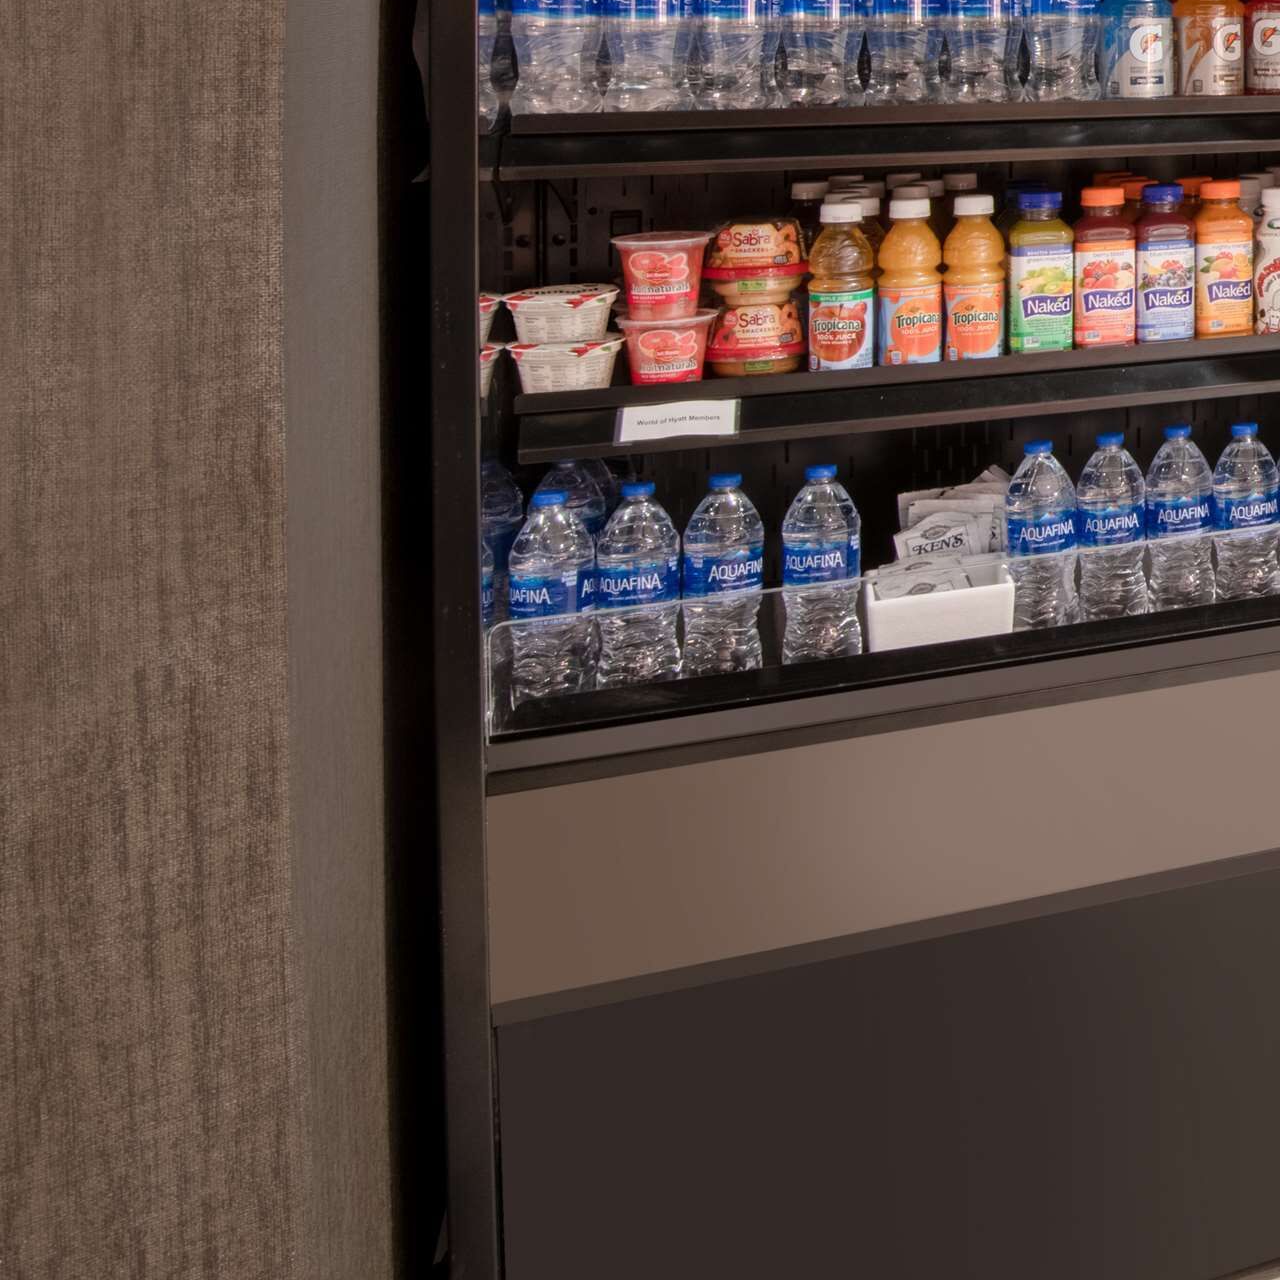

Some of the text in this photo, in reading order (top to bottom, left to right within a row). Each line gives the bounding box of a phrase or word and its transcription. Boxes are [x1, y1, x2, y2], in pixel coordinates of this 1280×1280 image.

[1129, 24, 1163, 64] G
[1213, 24, 1241, 62] G
[731, 232, 771, 247] Sabra
[1088, 291, 1131, 308] Naked
[1148, 291, 1191, 307] Naked
[1212, 284, 1252, 299] Naked
[1027, 297, 1071, 314] Naked
[738, 313, 777, 328] Sabra
[812, 320, 862, 333] Tropicana
[896, 312, 941, 328] Tropicana
[952, 311, 998, 326] Tropicana
[636, 414, 721, 427] World of Hyatt Members
[1158, 503, 1210, 524] AQUAFINA
[1019, 519, 1075, 543] AQUAFINA
[1084, 513, 1139, 533] AQUAFINA
[912, 532, 964, 556] KEN'S
[785, 553, 844, 571] AQUAFINA
[600, 573, 662, 594] AQUAFINA
